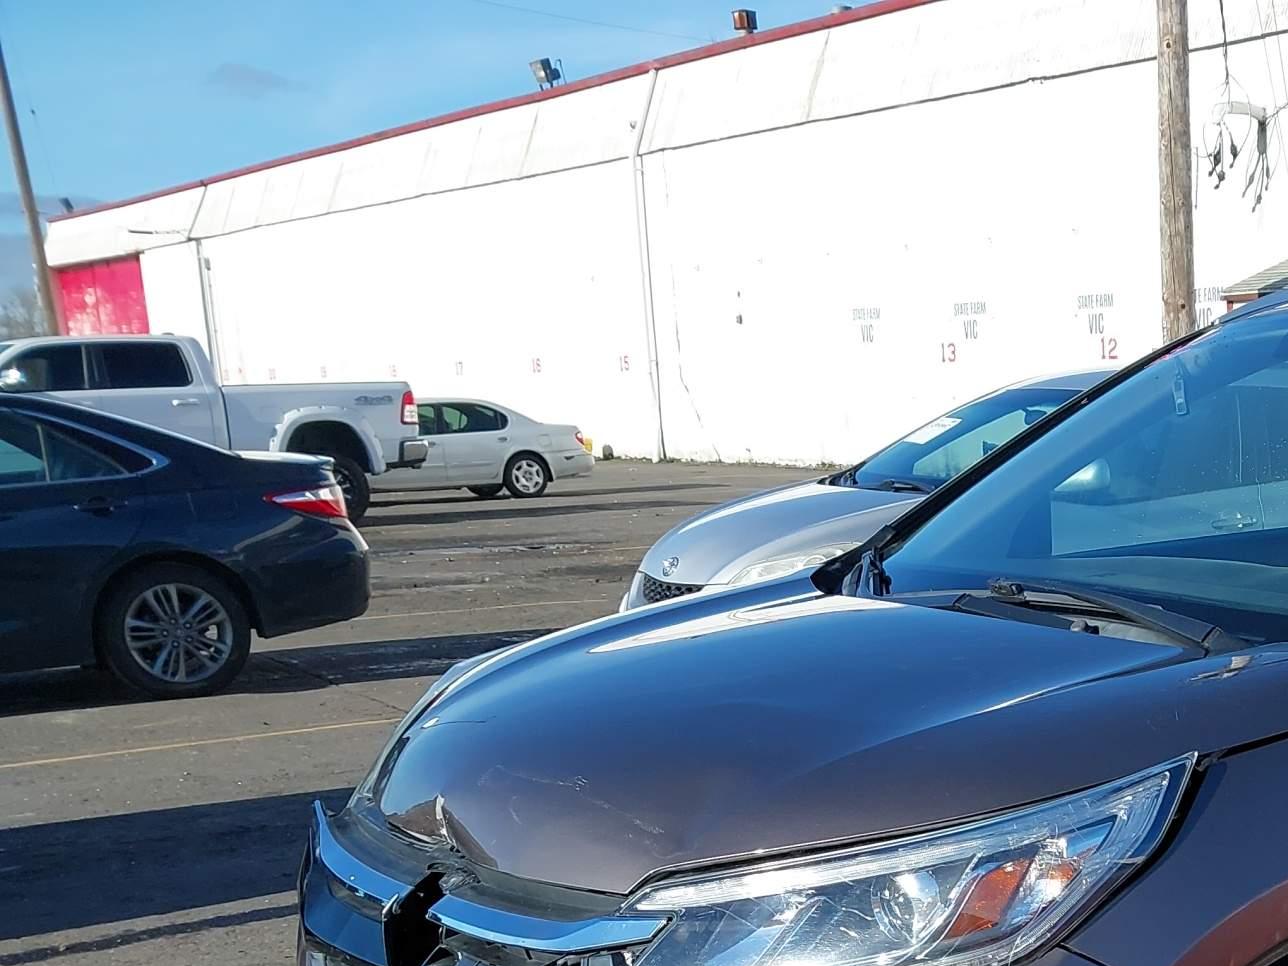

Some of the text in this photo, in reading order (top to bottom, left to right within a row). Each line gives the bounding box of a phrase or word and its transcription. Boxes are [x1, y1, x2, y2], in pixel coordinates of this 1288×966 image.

[1077, 293, 1114, 310] STATE FARM
[860, 324, 874, 343] VIC
[963, 319, 978, 340] VIC
[1088, 313, 1105, 335] VIC
[941, 342, 956, 363] 13
[1100, 336, 1118, 360] 12
[619, 355, 630, 372] 15
